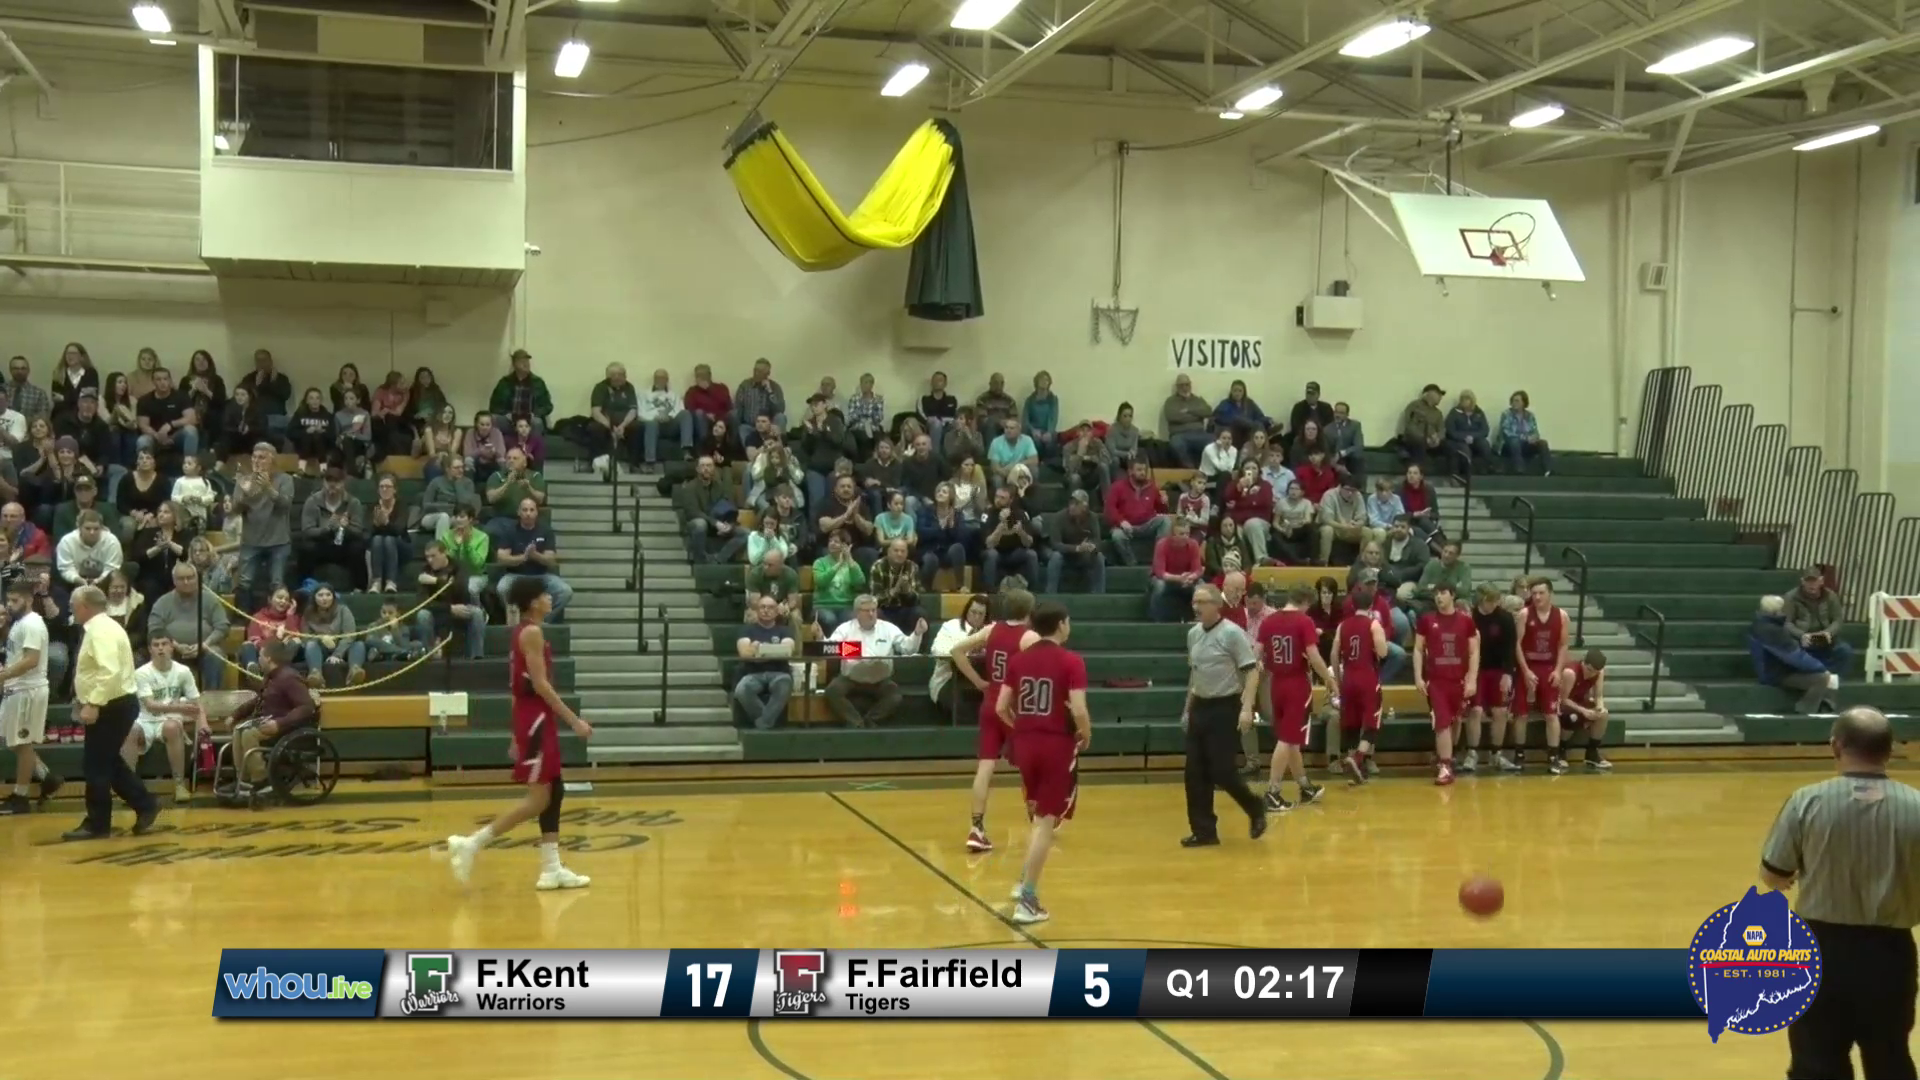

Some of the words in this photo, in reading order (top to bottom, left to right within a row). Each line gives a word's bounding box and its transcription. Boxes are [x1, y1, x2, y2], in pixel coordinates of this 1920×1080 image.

[1171, 338, 1262, 368] VISITORS
[1270, 635, 1293, 664] 21
[991, 650, 1008, 682] 5
[1018, 676, 1054, 716] 20
